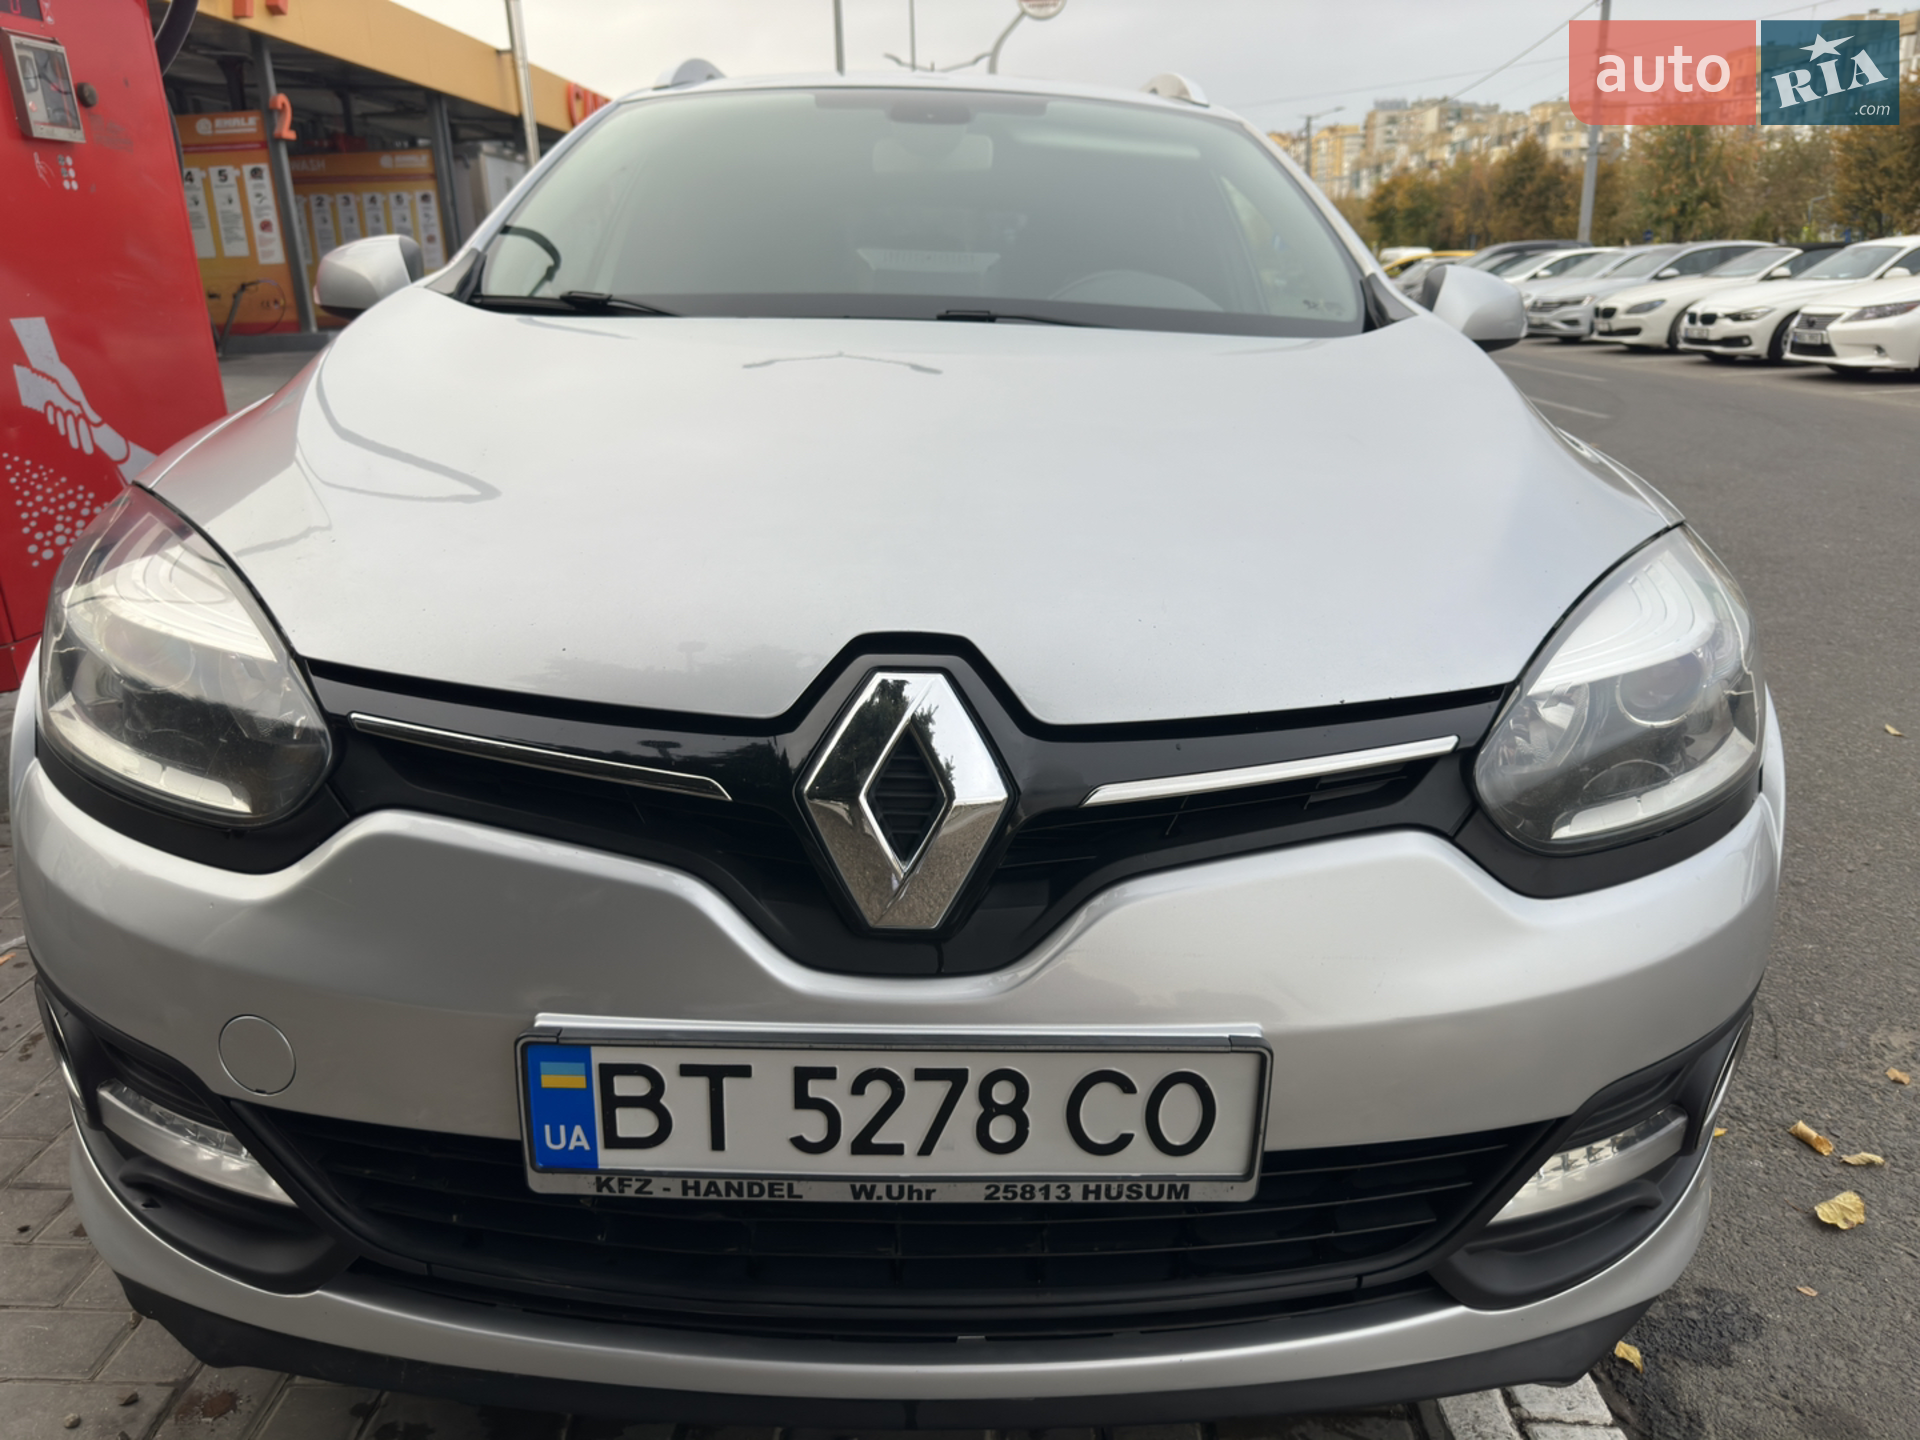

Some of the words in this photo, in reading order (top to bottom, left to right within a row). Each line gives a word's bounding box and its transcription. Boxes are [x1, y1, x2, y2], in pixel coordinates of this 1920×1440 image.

[269, 93, 297, 140] 2
[217, 168, 229, 183] 5
[598, 1062, 753, 1151] BT
[789, 1066, 1031, 1156] 5278
[1066, 1069, 1217, 1157] CO
[544, 1124, 591, 1151] UA
[595, 1175, 654, 1196] KFZ
[681, 1179, 804, 1200] HANDEL
[850, 1183, 937, 1202] W.Uhr
[984, 1183, 1072, 1202] 25813
[1082, 1182, 1191, 1201] HUSUM
